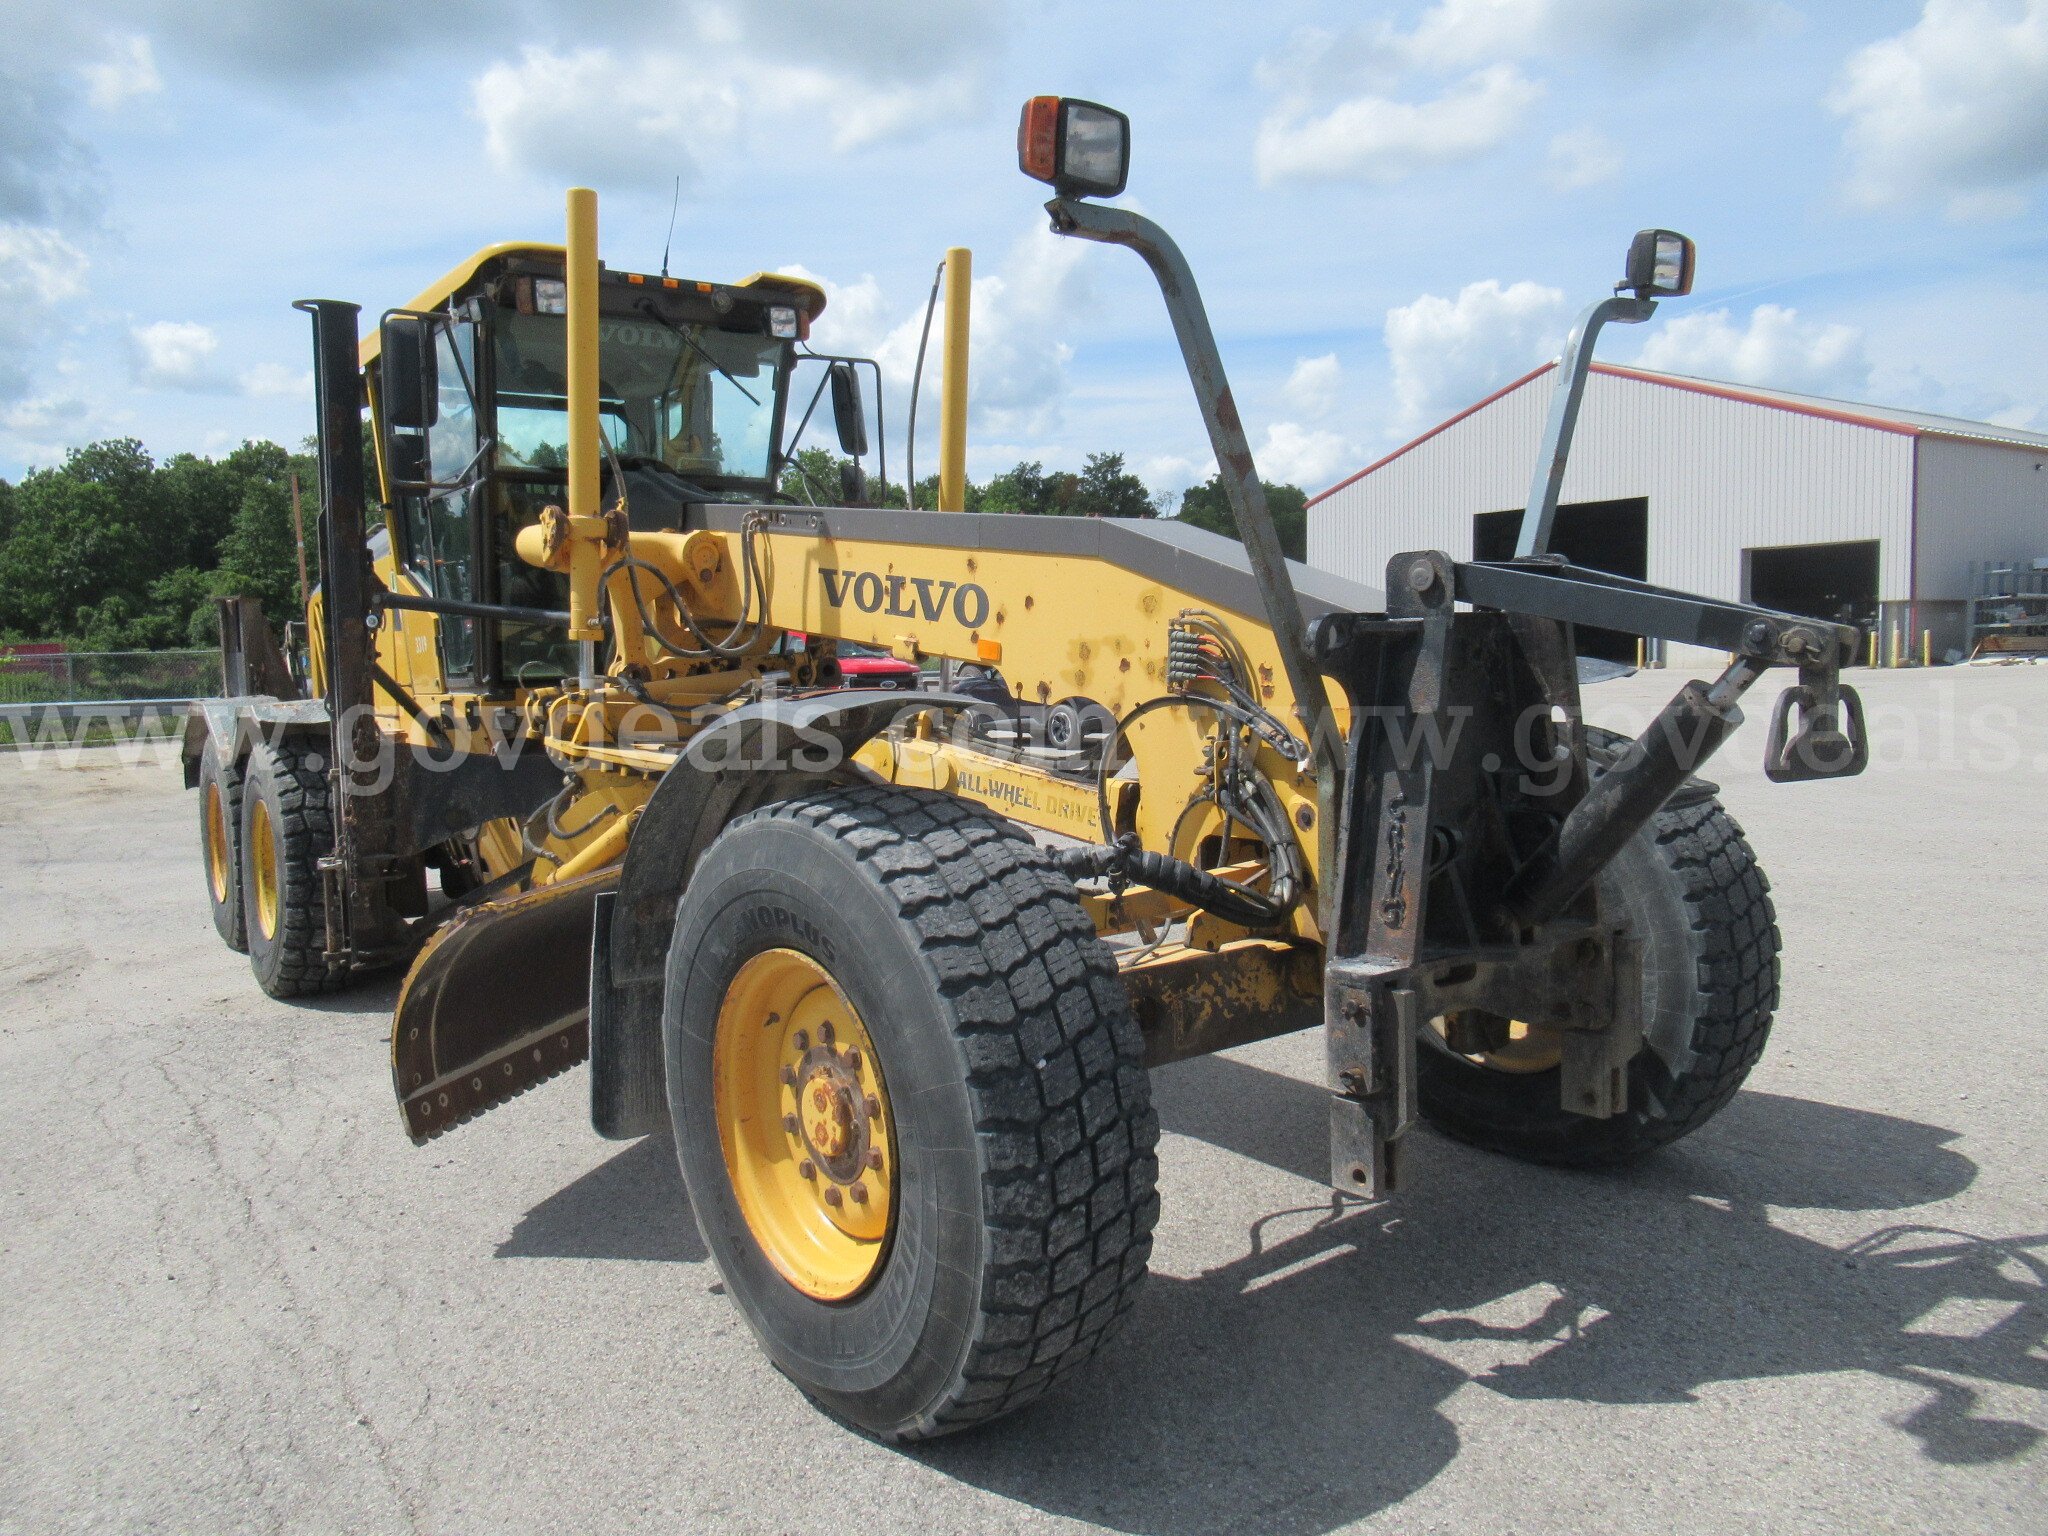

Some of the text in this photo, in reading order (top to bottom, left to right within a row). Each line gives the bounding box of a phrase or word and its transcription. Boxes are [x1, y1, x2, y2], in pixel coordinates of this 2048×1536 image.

[600, 321, 708, 350] VOLV
[818, 567, 990, 629] VOLVO
[1045, 795, 1098, 827] DRIVE
